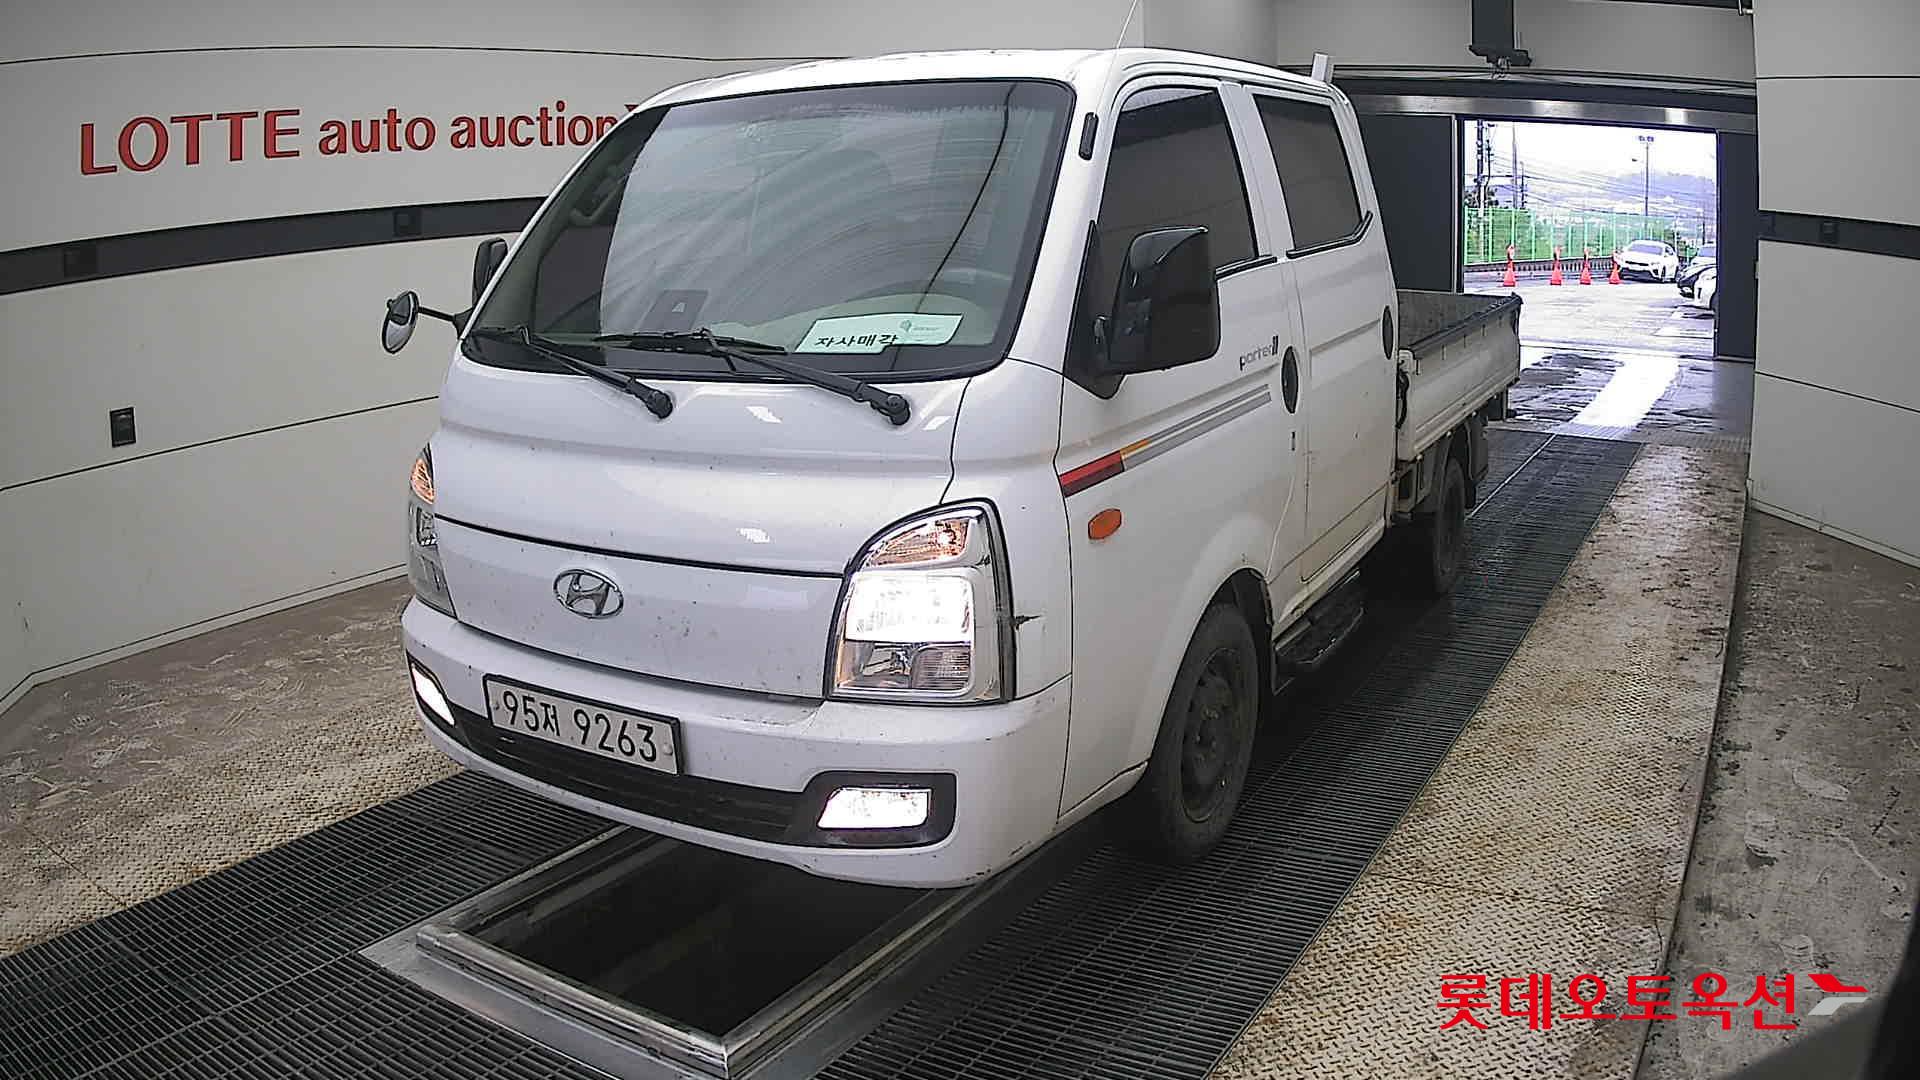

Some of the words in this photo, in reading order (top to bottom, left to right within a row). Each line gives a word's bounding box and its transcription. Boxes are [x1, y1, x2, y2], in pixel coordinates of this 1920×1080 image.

[79, 108, 301, 176] LOTTE
[317, 108, 436, 156] auto
[449, 100, 618, 149] auction
[815, 334, 899, 347] 자사매각
[503, 690, 561, 737] 95저
[573, 708, 657, 762] 9263
